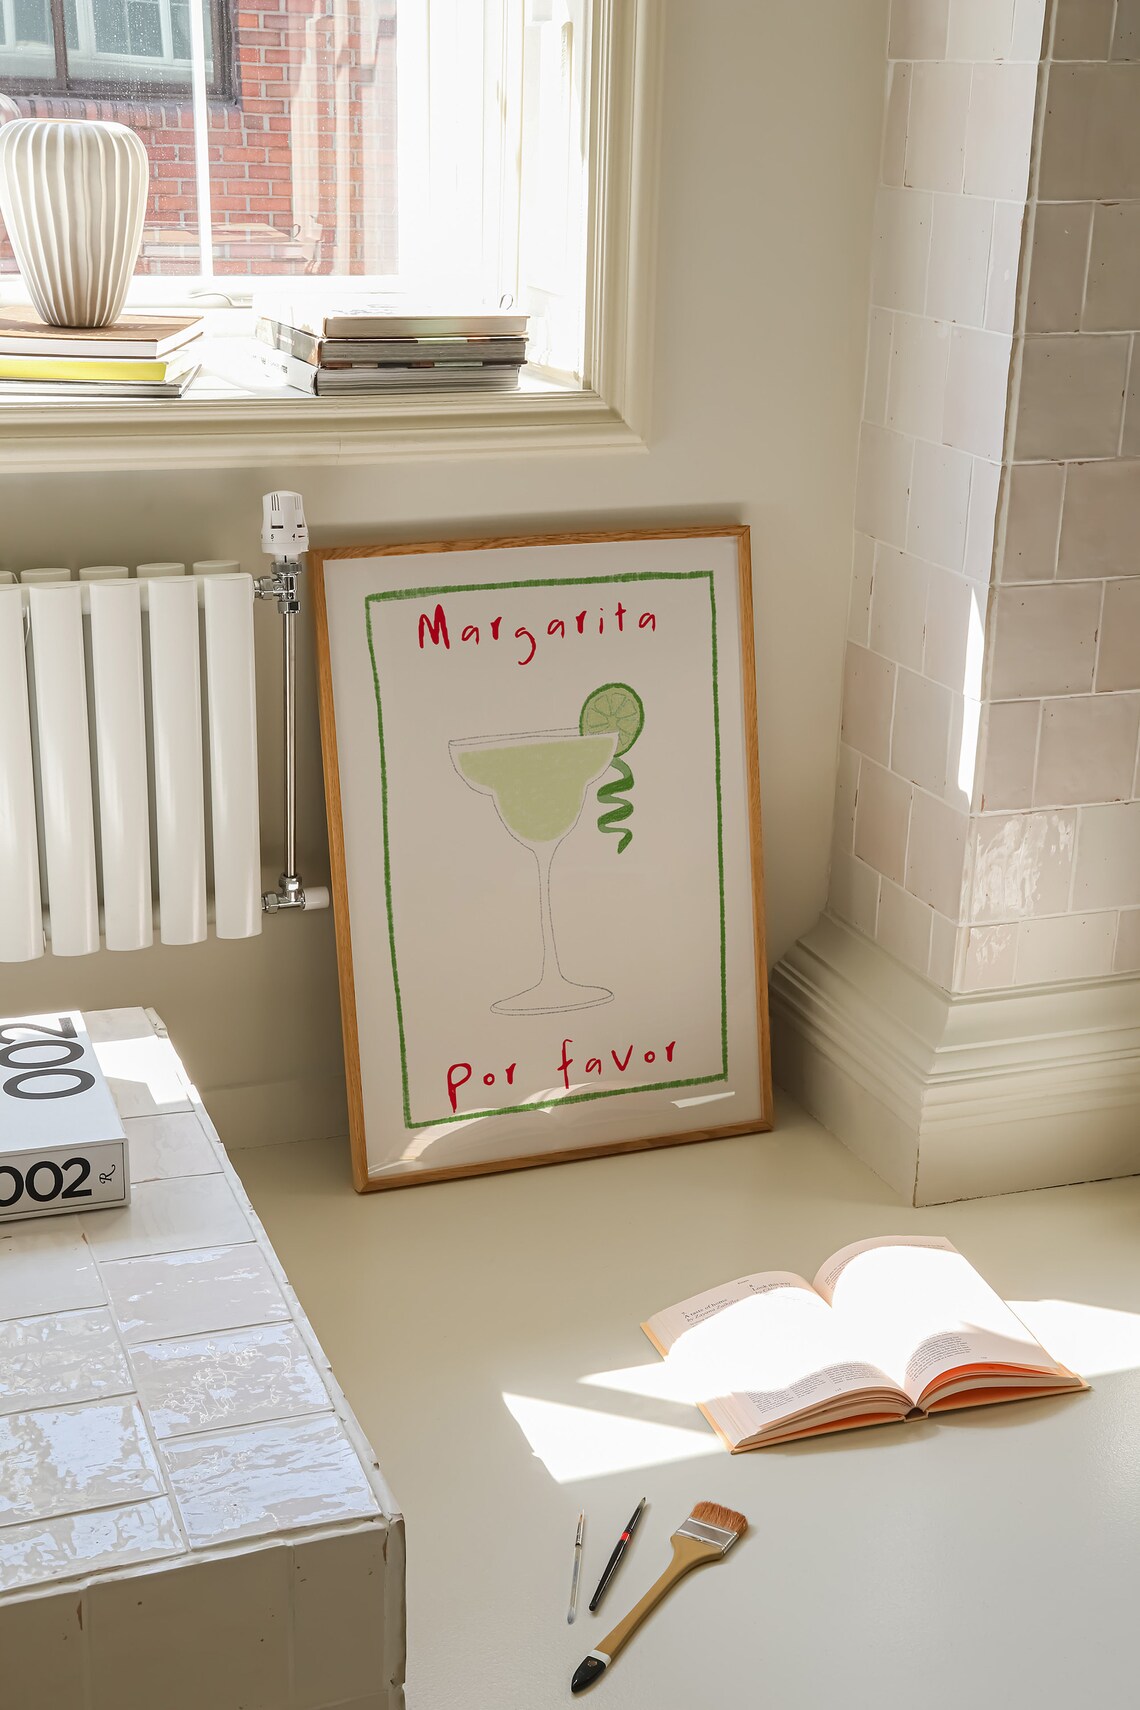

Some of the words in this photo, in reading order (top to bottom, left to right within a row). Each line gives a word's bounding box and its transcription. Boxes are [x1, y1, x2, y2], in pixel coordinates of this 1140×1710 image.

[418, 602, 656, 665] Margarita
[0, 1016, 96, 1100] 002
[557, 1038, 676, 1089] favor
